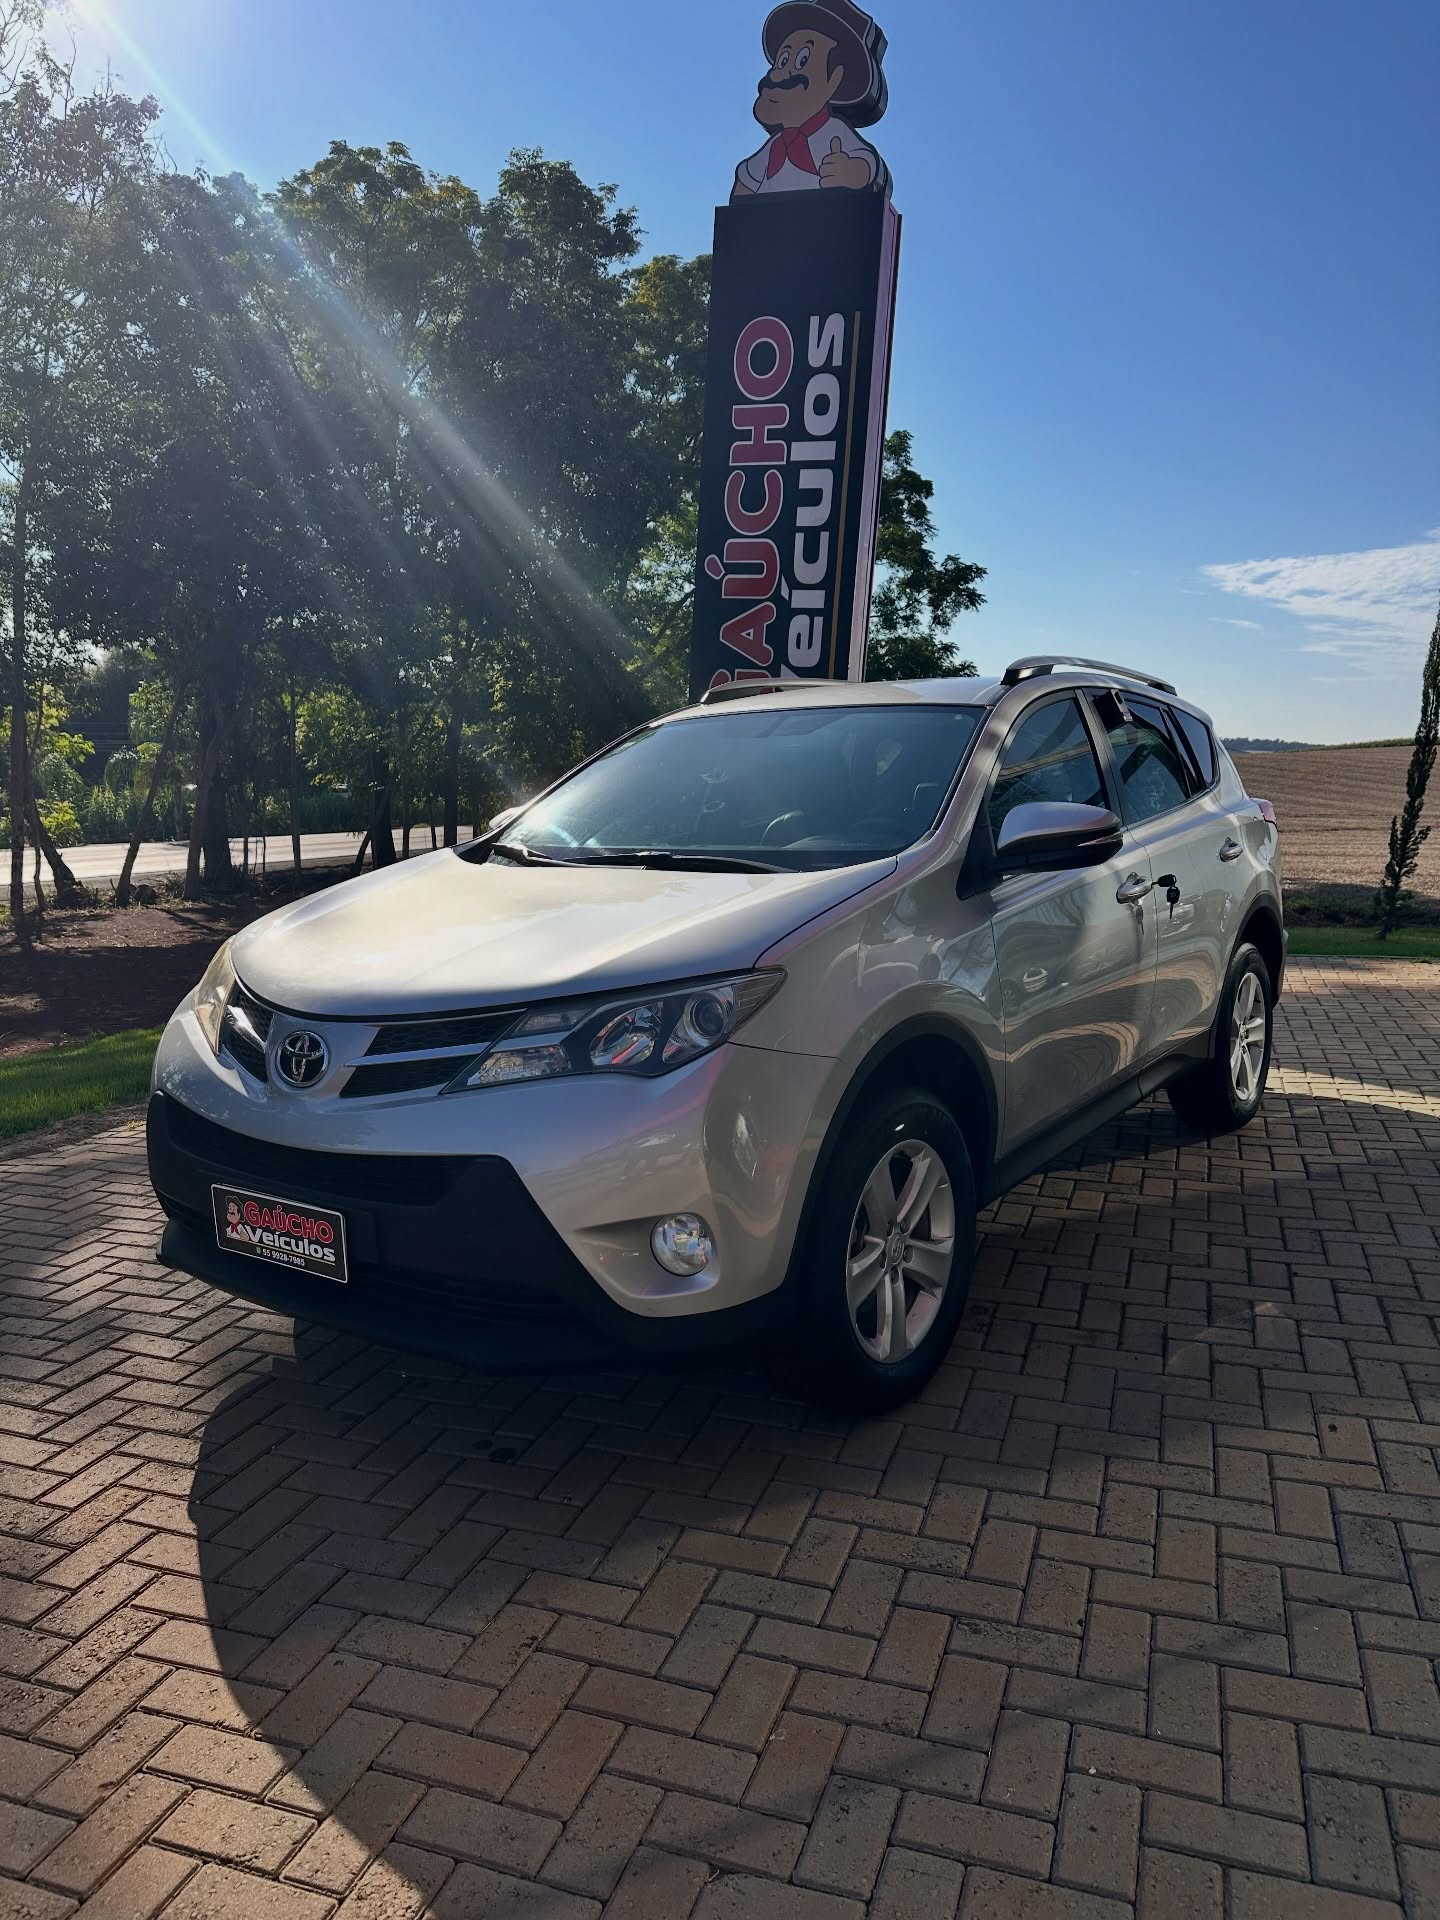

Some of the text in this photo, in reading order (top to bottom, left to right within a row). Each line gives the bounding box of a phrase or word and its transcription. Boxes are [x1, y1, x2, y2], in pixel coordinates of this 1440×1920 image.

[779, 312, 845, 680] eículos
[244, 1201, 334, 1244] GAÚCHO
[245, 1225, 336, 1262] Veículos
[262, 1248, 270, 1256] 55
